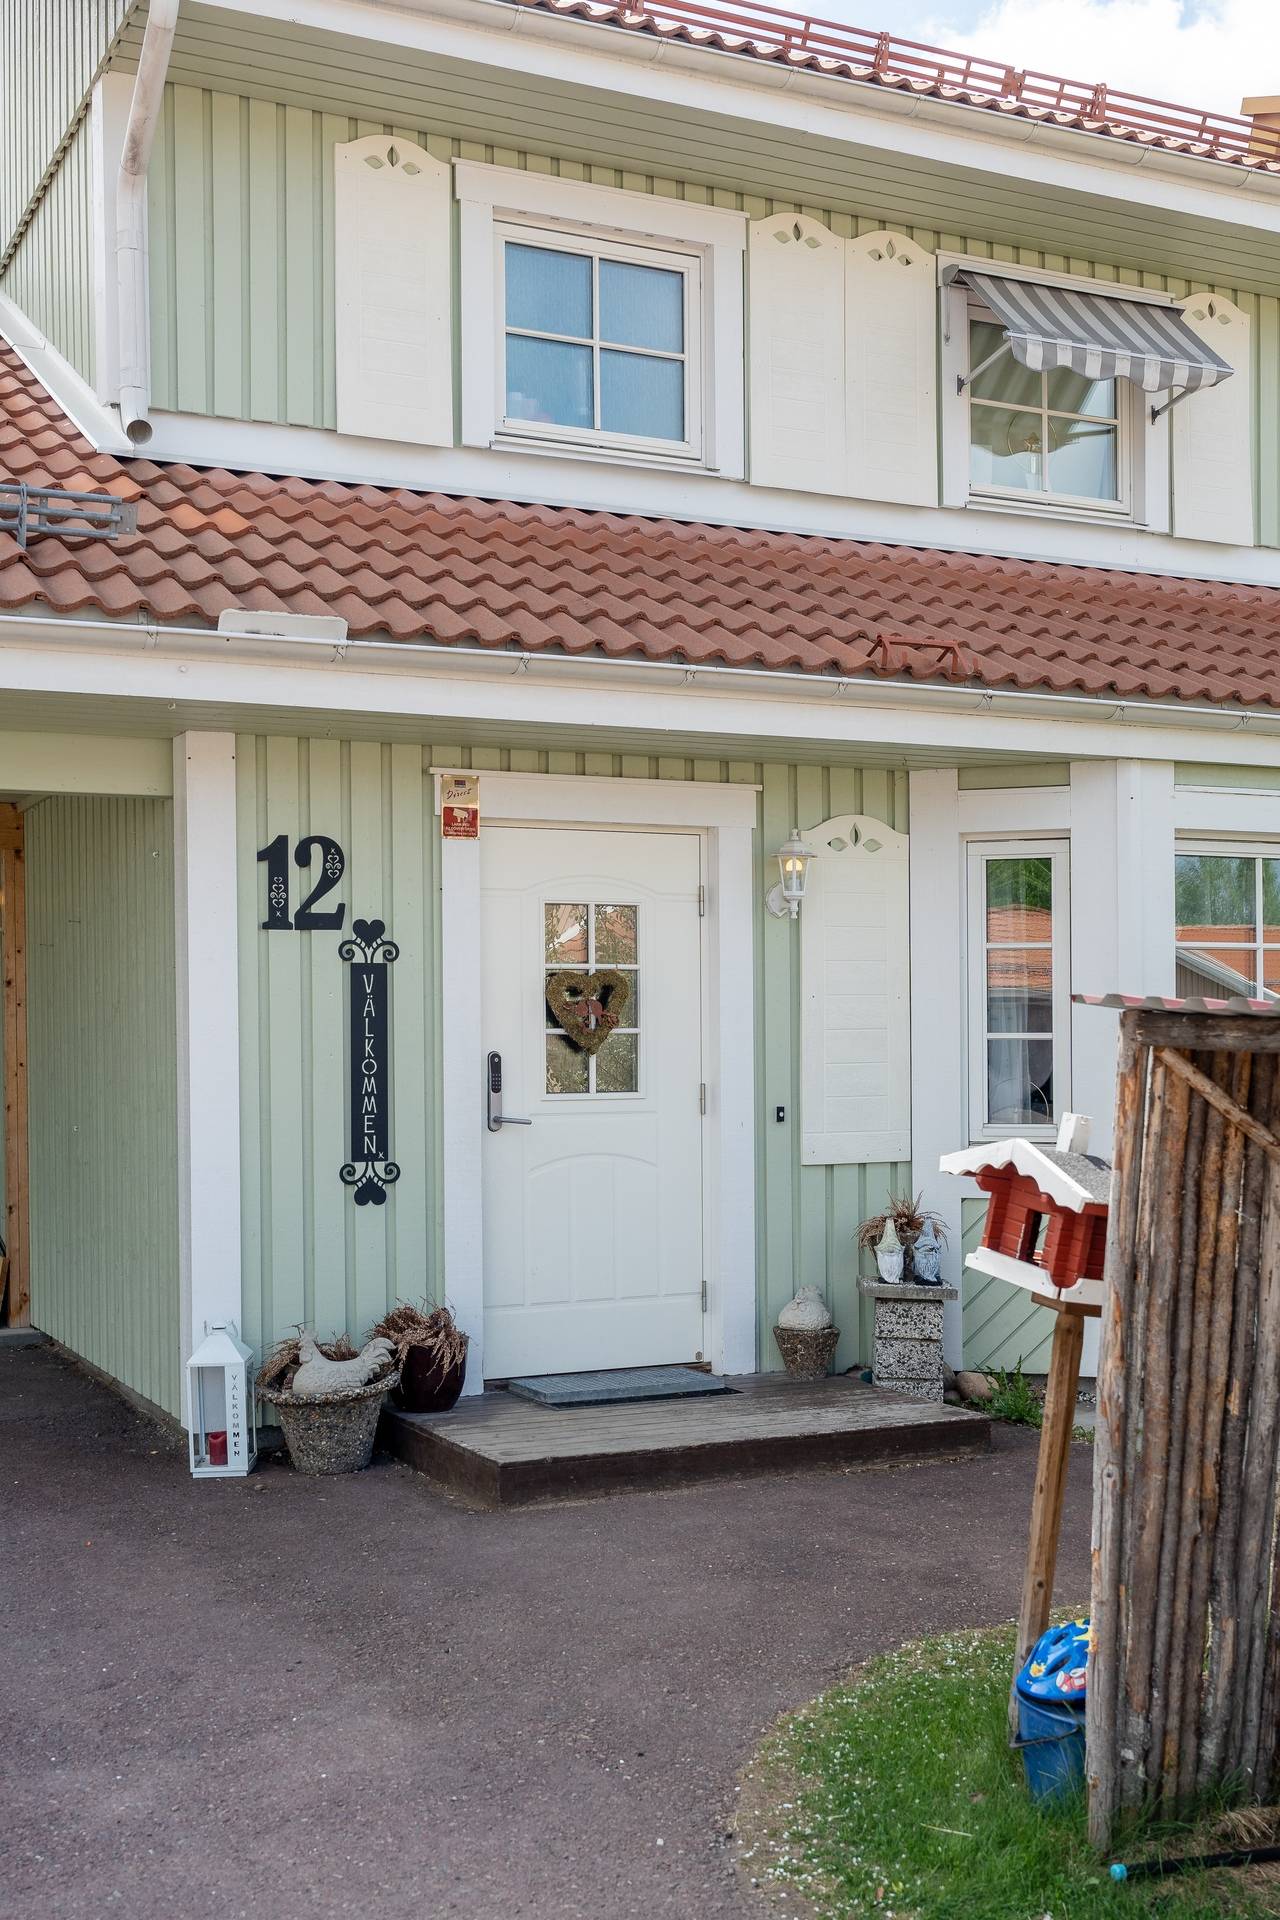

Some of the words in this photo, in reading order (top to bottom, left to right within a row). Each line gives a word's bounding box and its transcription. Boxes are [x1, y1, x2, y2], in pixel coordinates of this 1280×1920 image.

[256, 834, 346, 931] 12
[361, 973, 378, 1155] VÄLKOMMEN
[231, 1374, 241, 1457] VÄLKOMMEN
